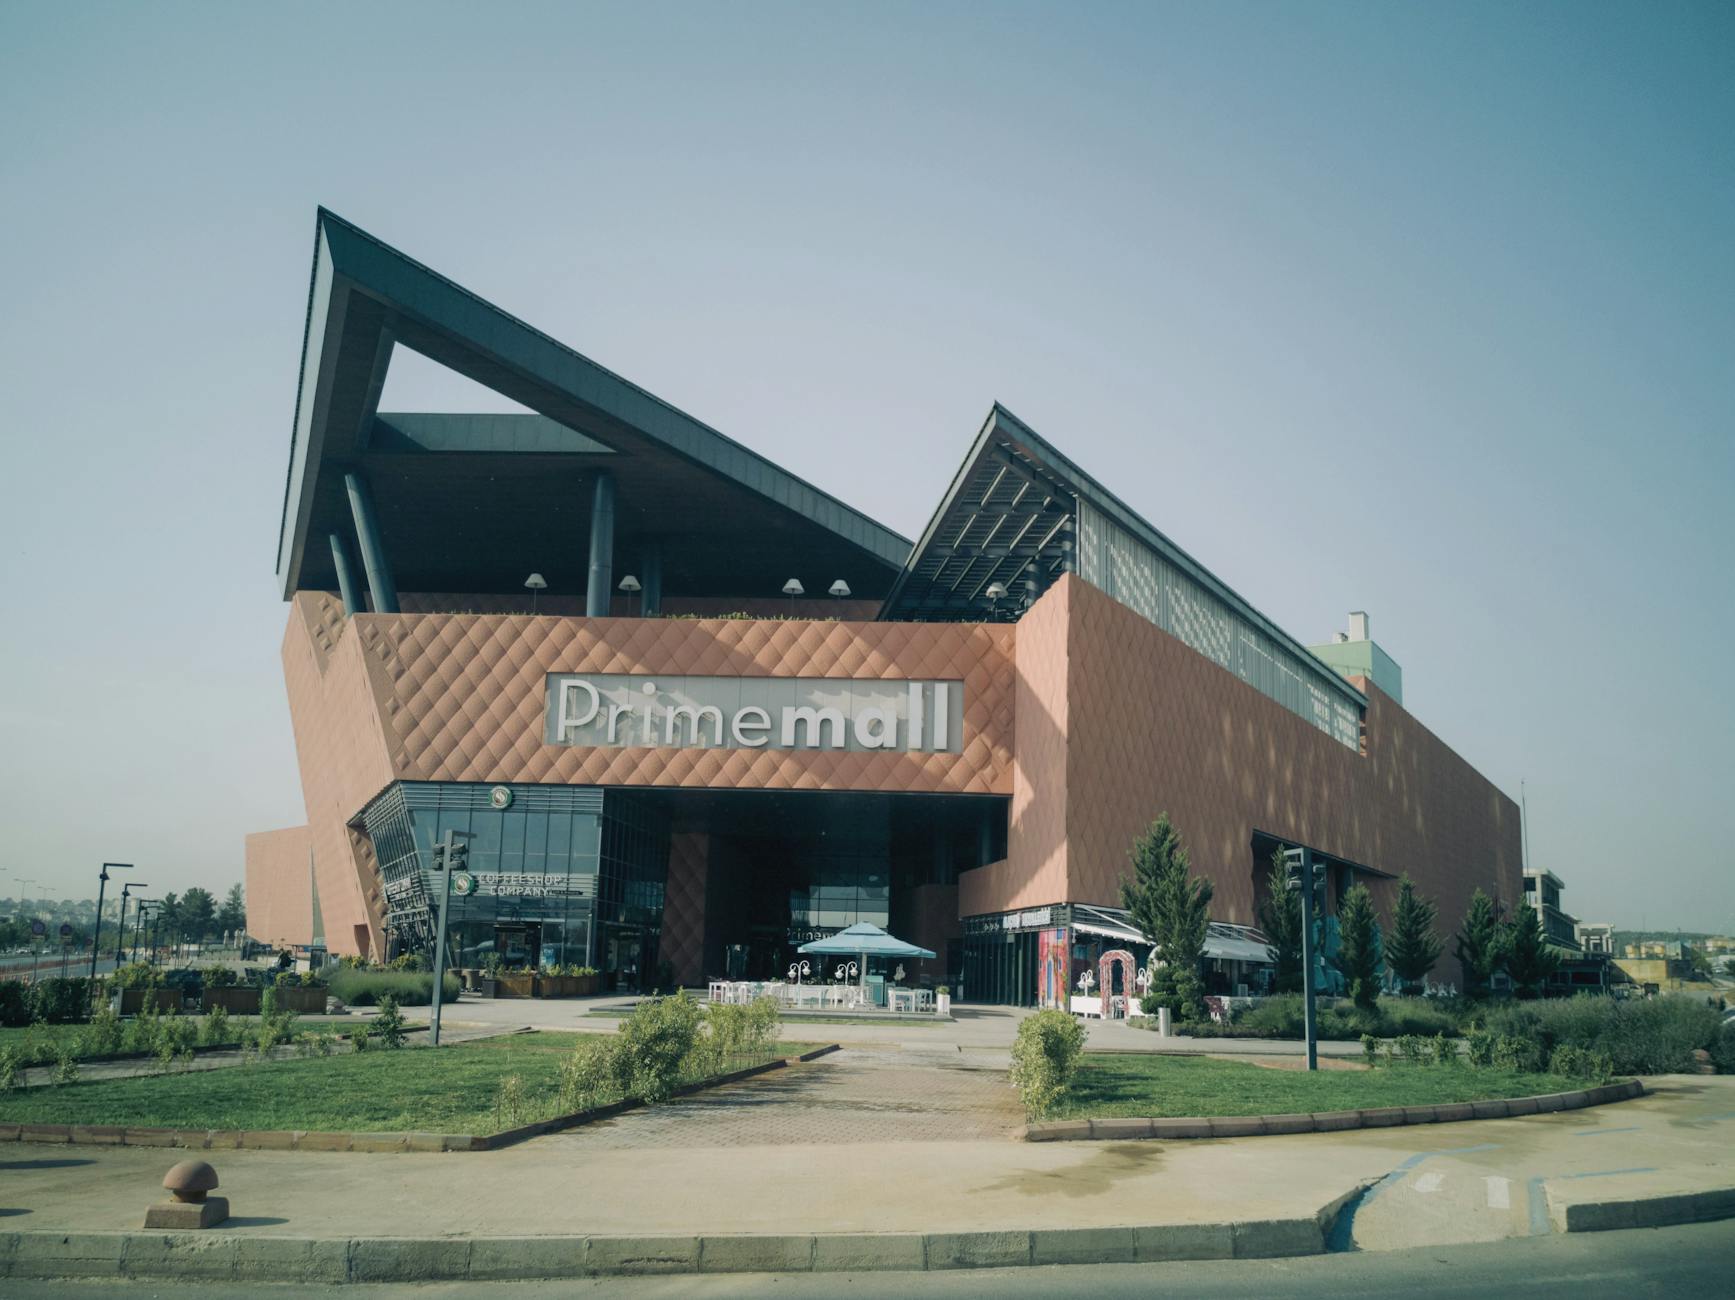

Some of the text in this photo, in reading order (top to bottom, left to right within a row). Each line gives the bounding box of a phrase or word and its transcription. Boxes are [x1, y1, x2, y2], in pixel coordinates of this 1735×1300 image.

[556, 678, 949, 750] Primemall
[479, 873, 561, 885] COFFEESHOP
[490, 885, 549, 896] COMPANY
